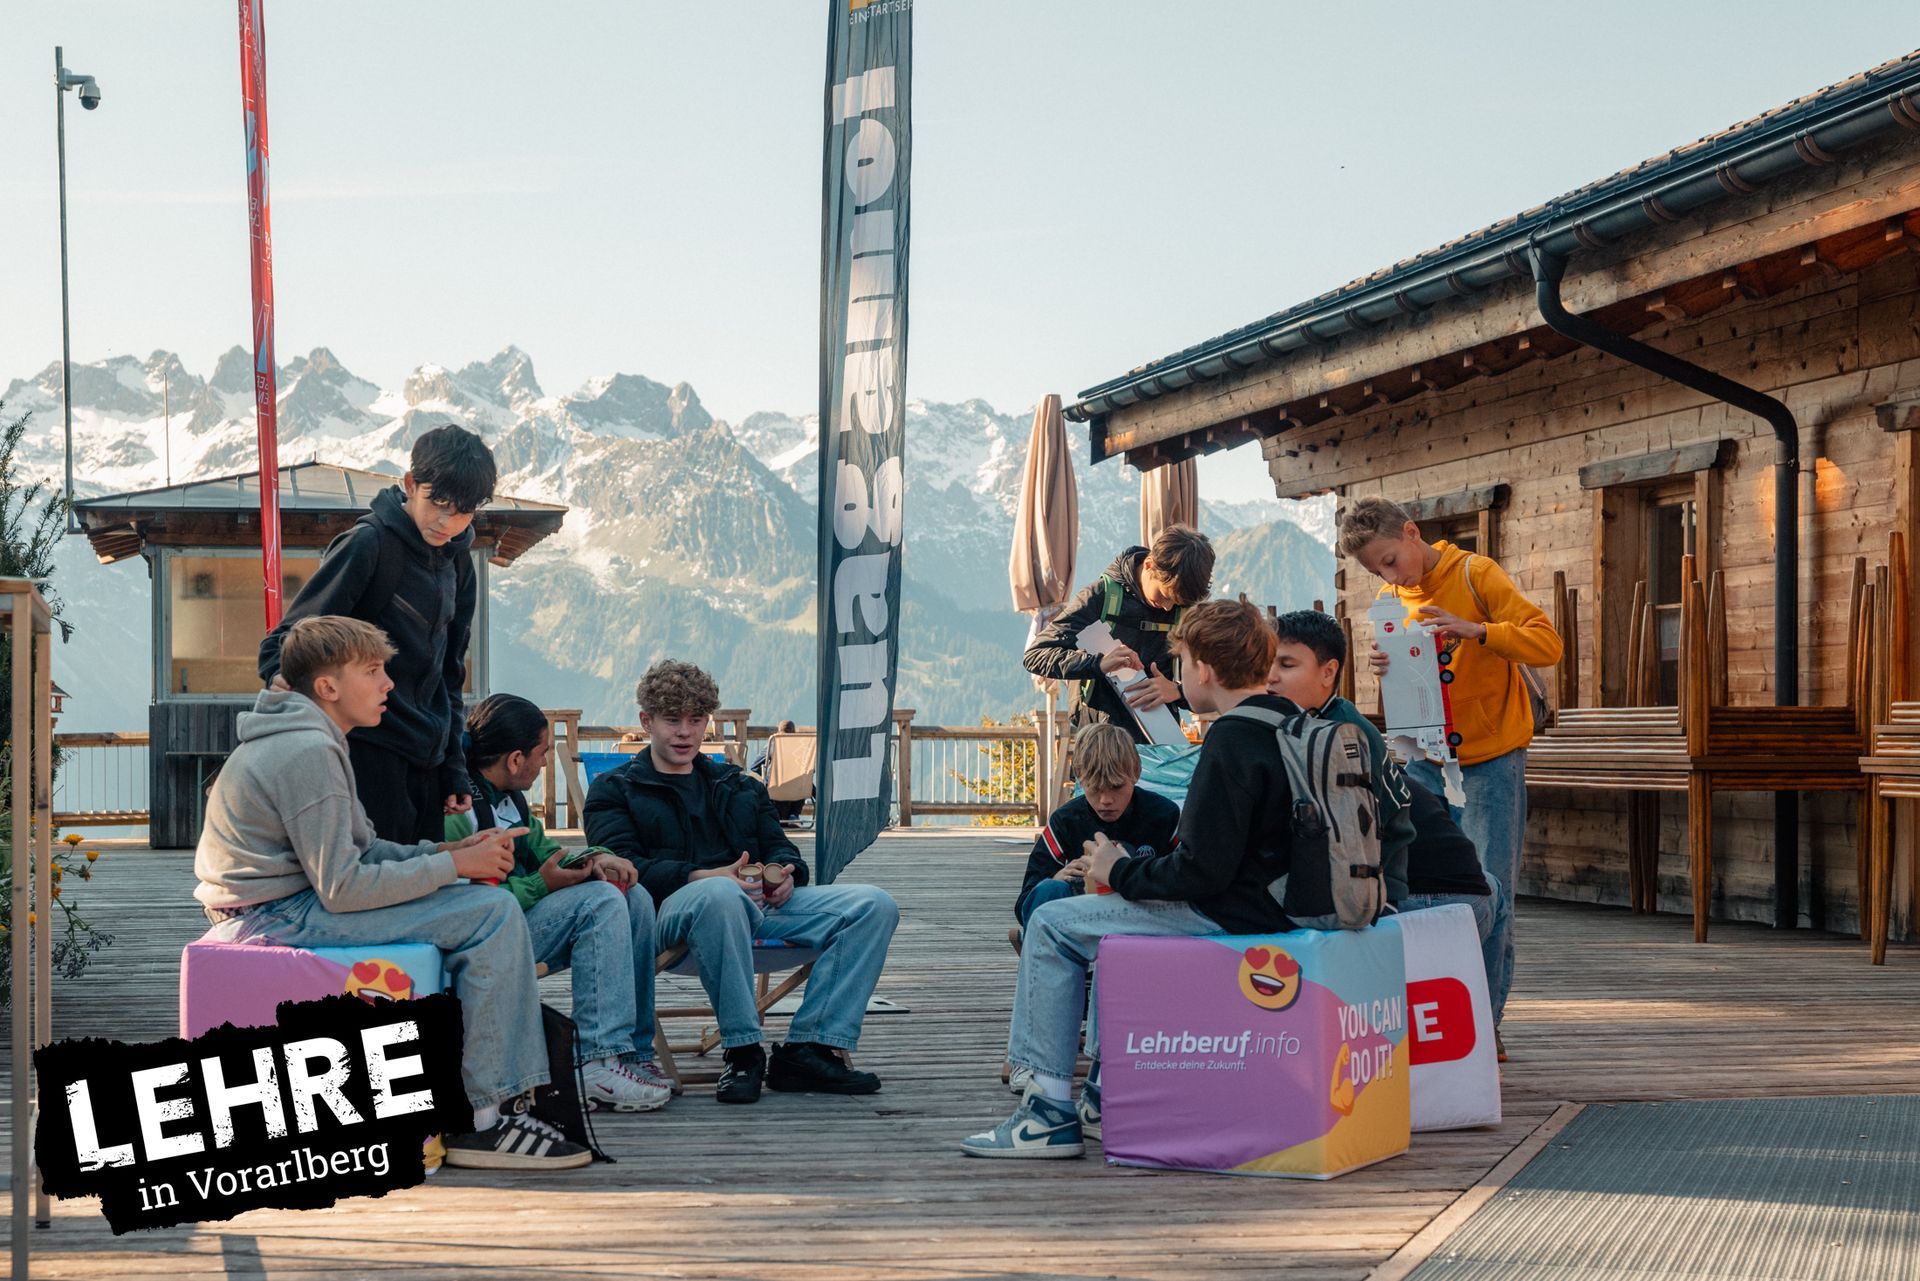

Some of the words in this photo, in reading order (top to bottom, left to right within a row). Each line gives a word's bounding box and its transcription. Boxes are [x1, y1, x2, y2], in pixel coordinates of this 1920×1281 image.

[1338, 1002, 1368, 1041] YOU
[1372, 995, 1402, 1034] CAN
[1126, 1030, 1301, 1058] Lehrberuf.info
[1135, 1060, 1178, 1071] Entdecke
[1180, 1060, 1205, 1071] deine
[1207, 1060, 1247, 1072] Zukunft.
[1351, 1049, 1371, 1086] DO
[1375, 1043, 1393, 1080] IT!
